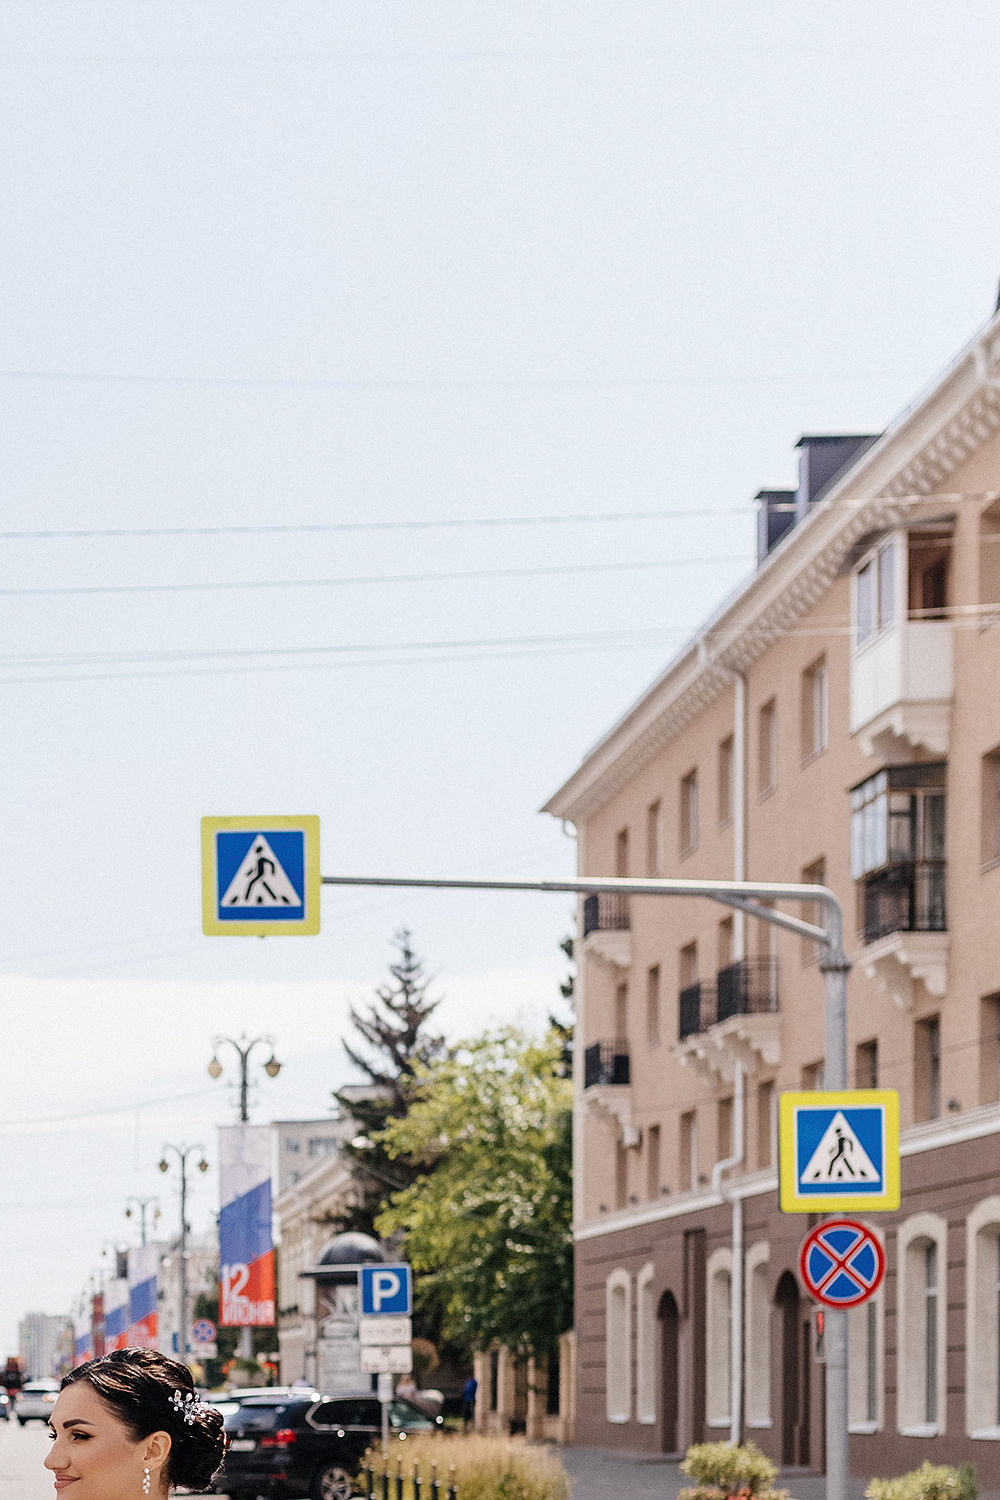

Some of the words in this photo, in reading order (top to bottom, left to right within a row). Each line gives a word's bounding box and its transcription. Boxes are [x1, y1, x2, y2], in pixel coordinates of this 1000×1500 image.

[222, 1264, 249, 1302] 12
[372, 1270, 400, 1311] P
[223, 1301, 275, 1324] ИЮНЯ
